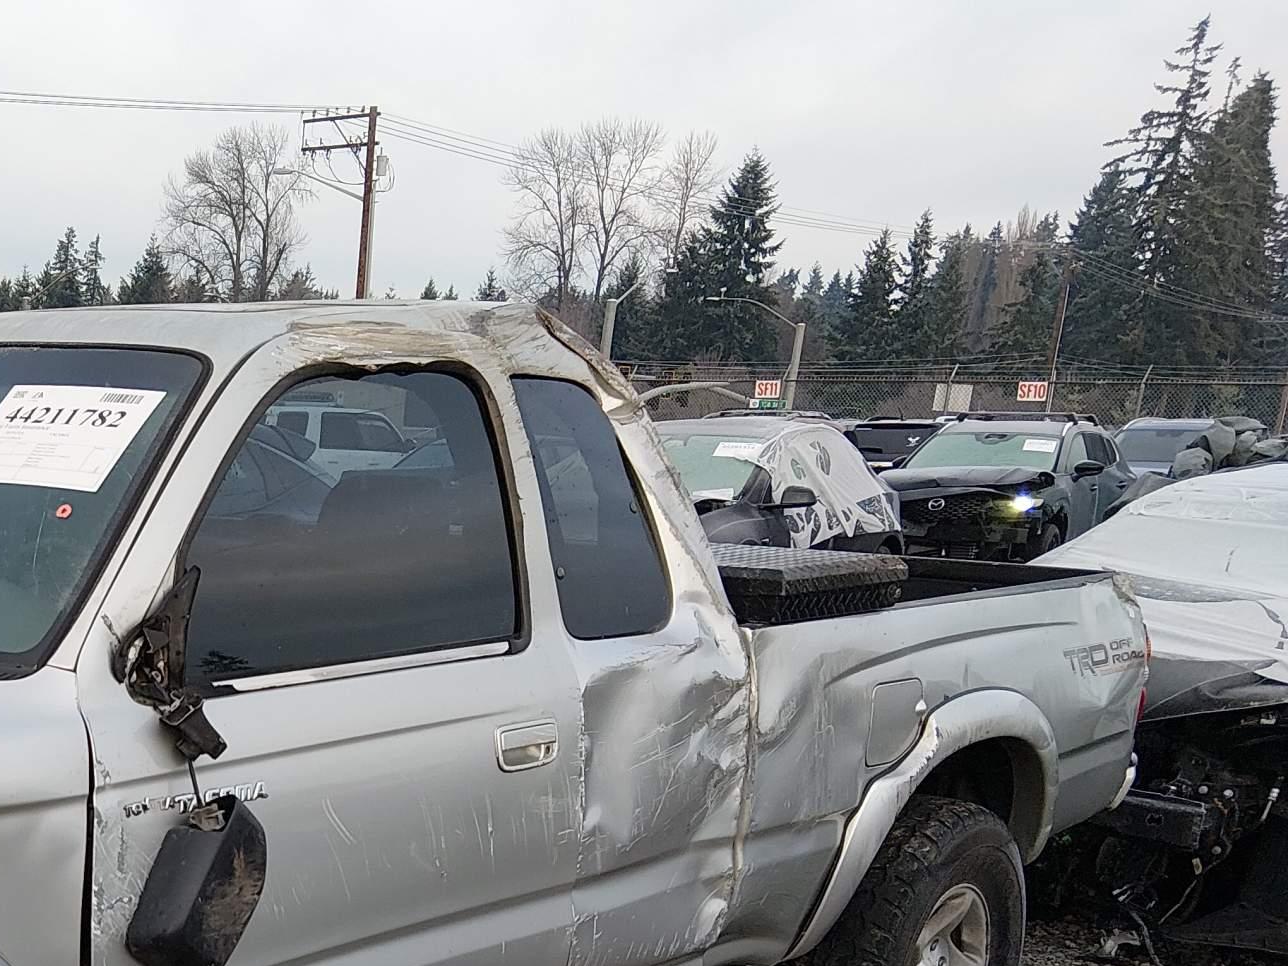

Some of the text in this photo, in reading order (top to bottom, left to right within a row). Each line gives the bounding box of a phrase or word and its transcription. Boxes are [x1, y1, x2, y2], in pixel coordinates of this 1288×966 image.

[757, 382, 778, 397] SF11
[1019, 383, 1046, 399] SF10
[5, 406, 127, 428] 44211782
[1063, 643, 1109, 678] TRD
